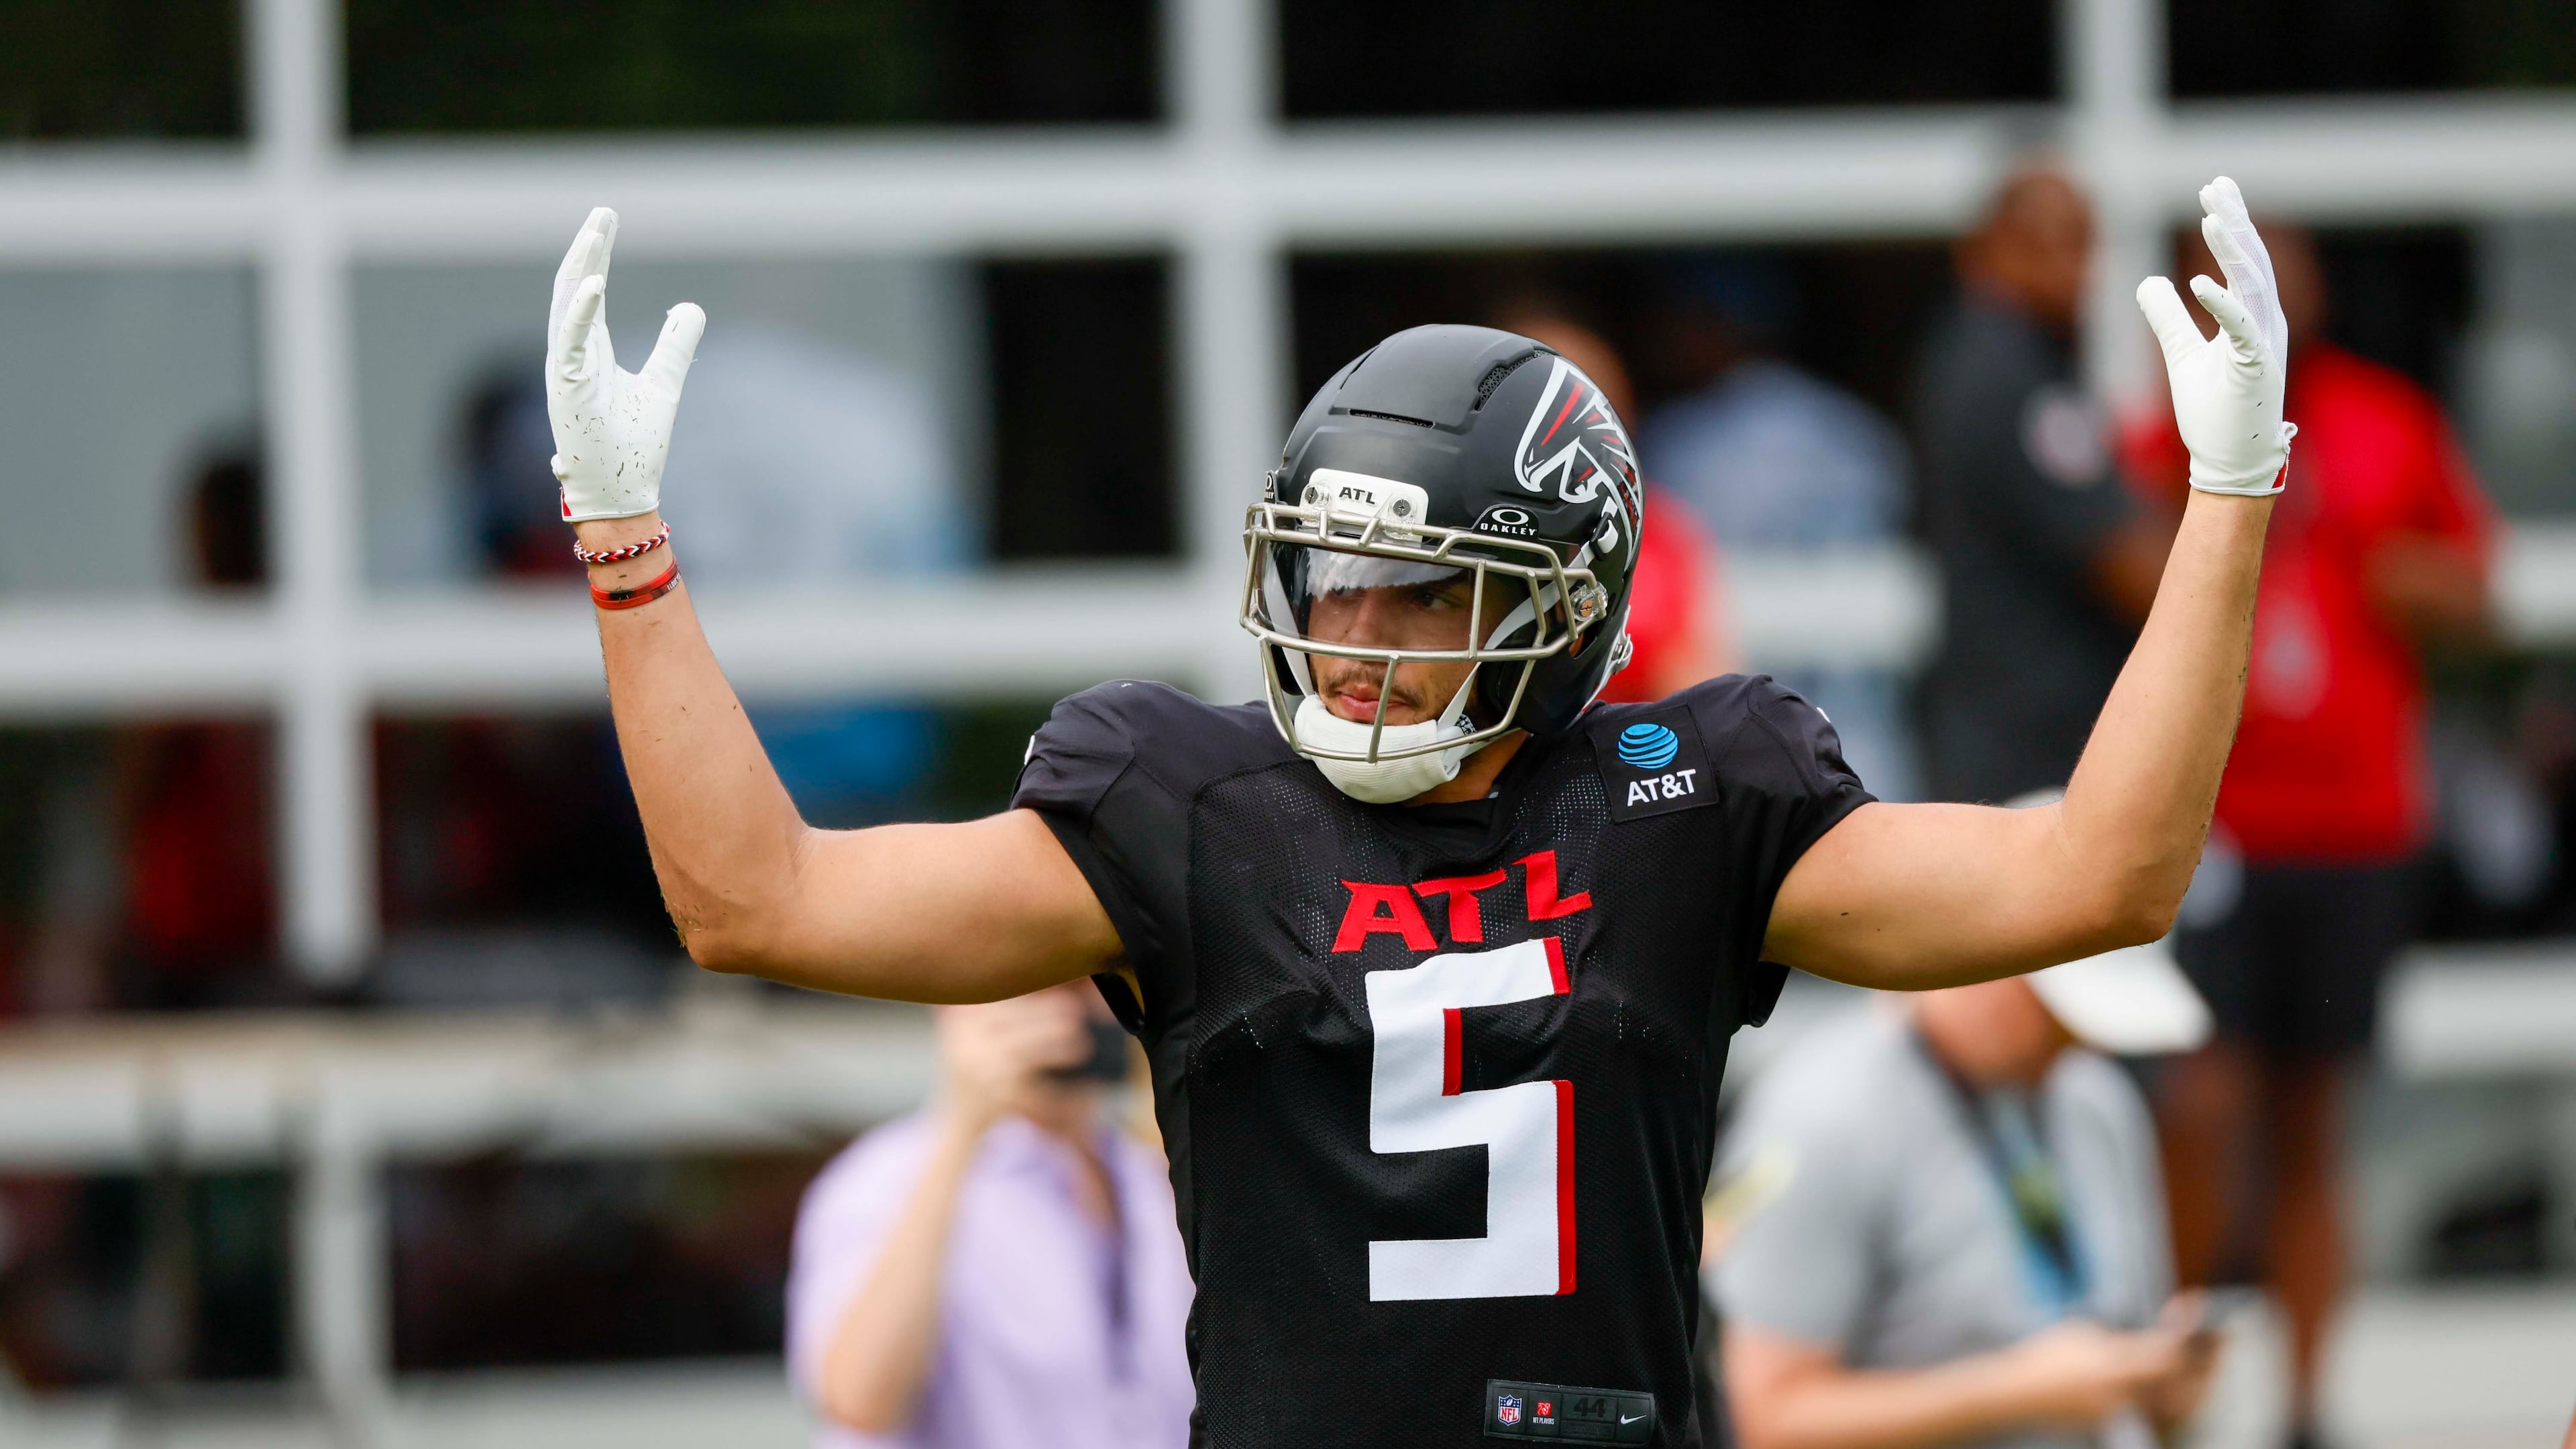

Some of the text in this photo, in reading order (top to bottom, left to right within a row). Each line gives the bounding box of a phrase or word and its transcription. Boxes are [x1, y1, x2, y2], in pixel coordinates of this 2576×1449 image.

[1339, 486, 1375, 504] ATL
[1480, 523, 1536, 536] OAKLEY
[1627, 769, 1696, 806] AT&T
[1332, 849, 1593, 953] ATL
[1364, 936, 1576, 1301] 5
[1501, 1407, 1517, 1421] NFL
[1573, 1397, 1605, 1417] 44
